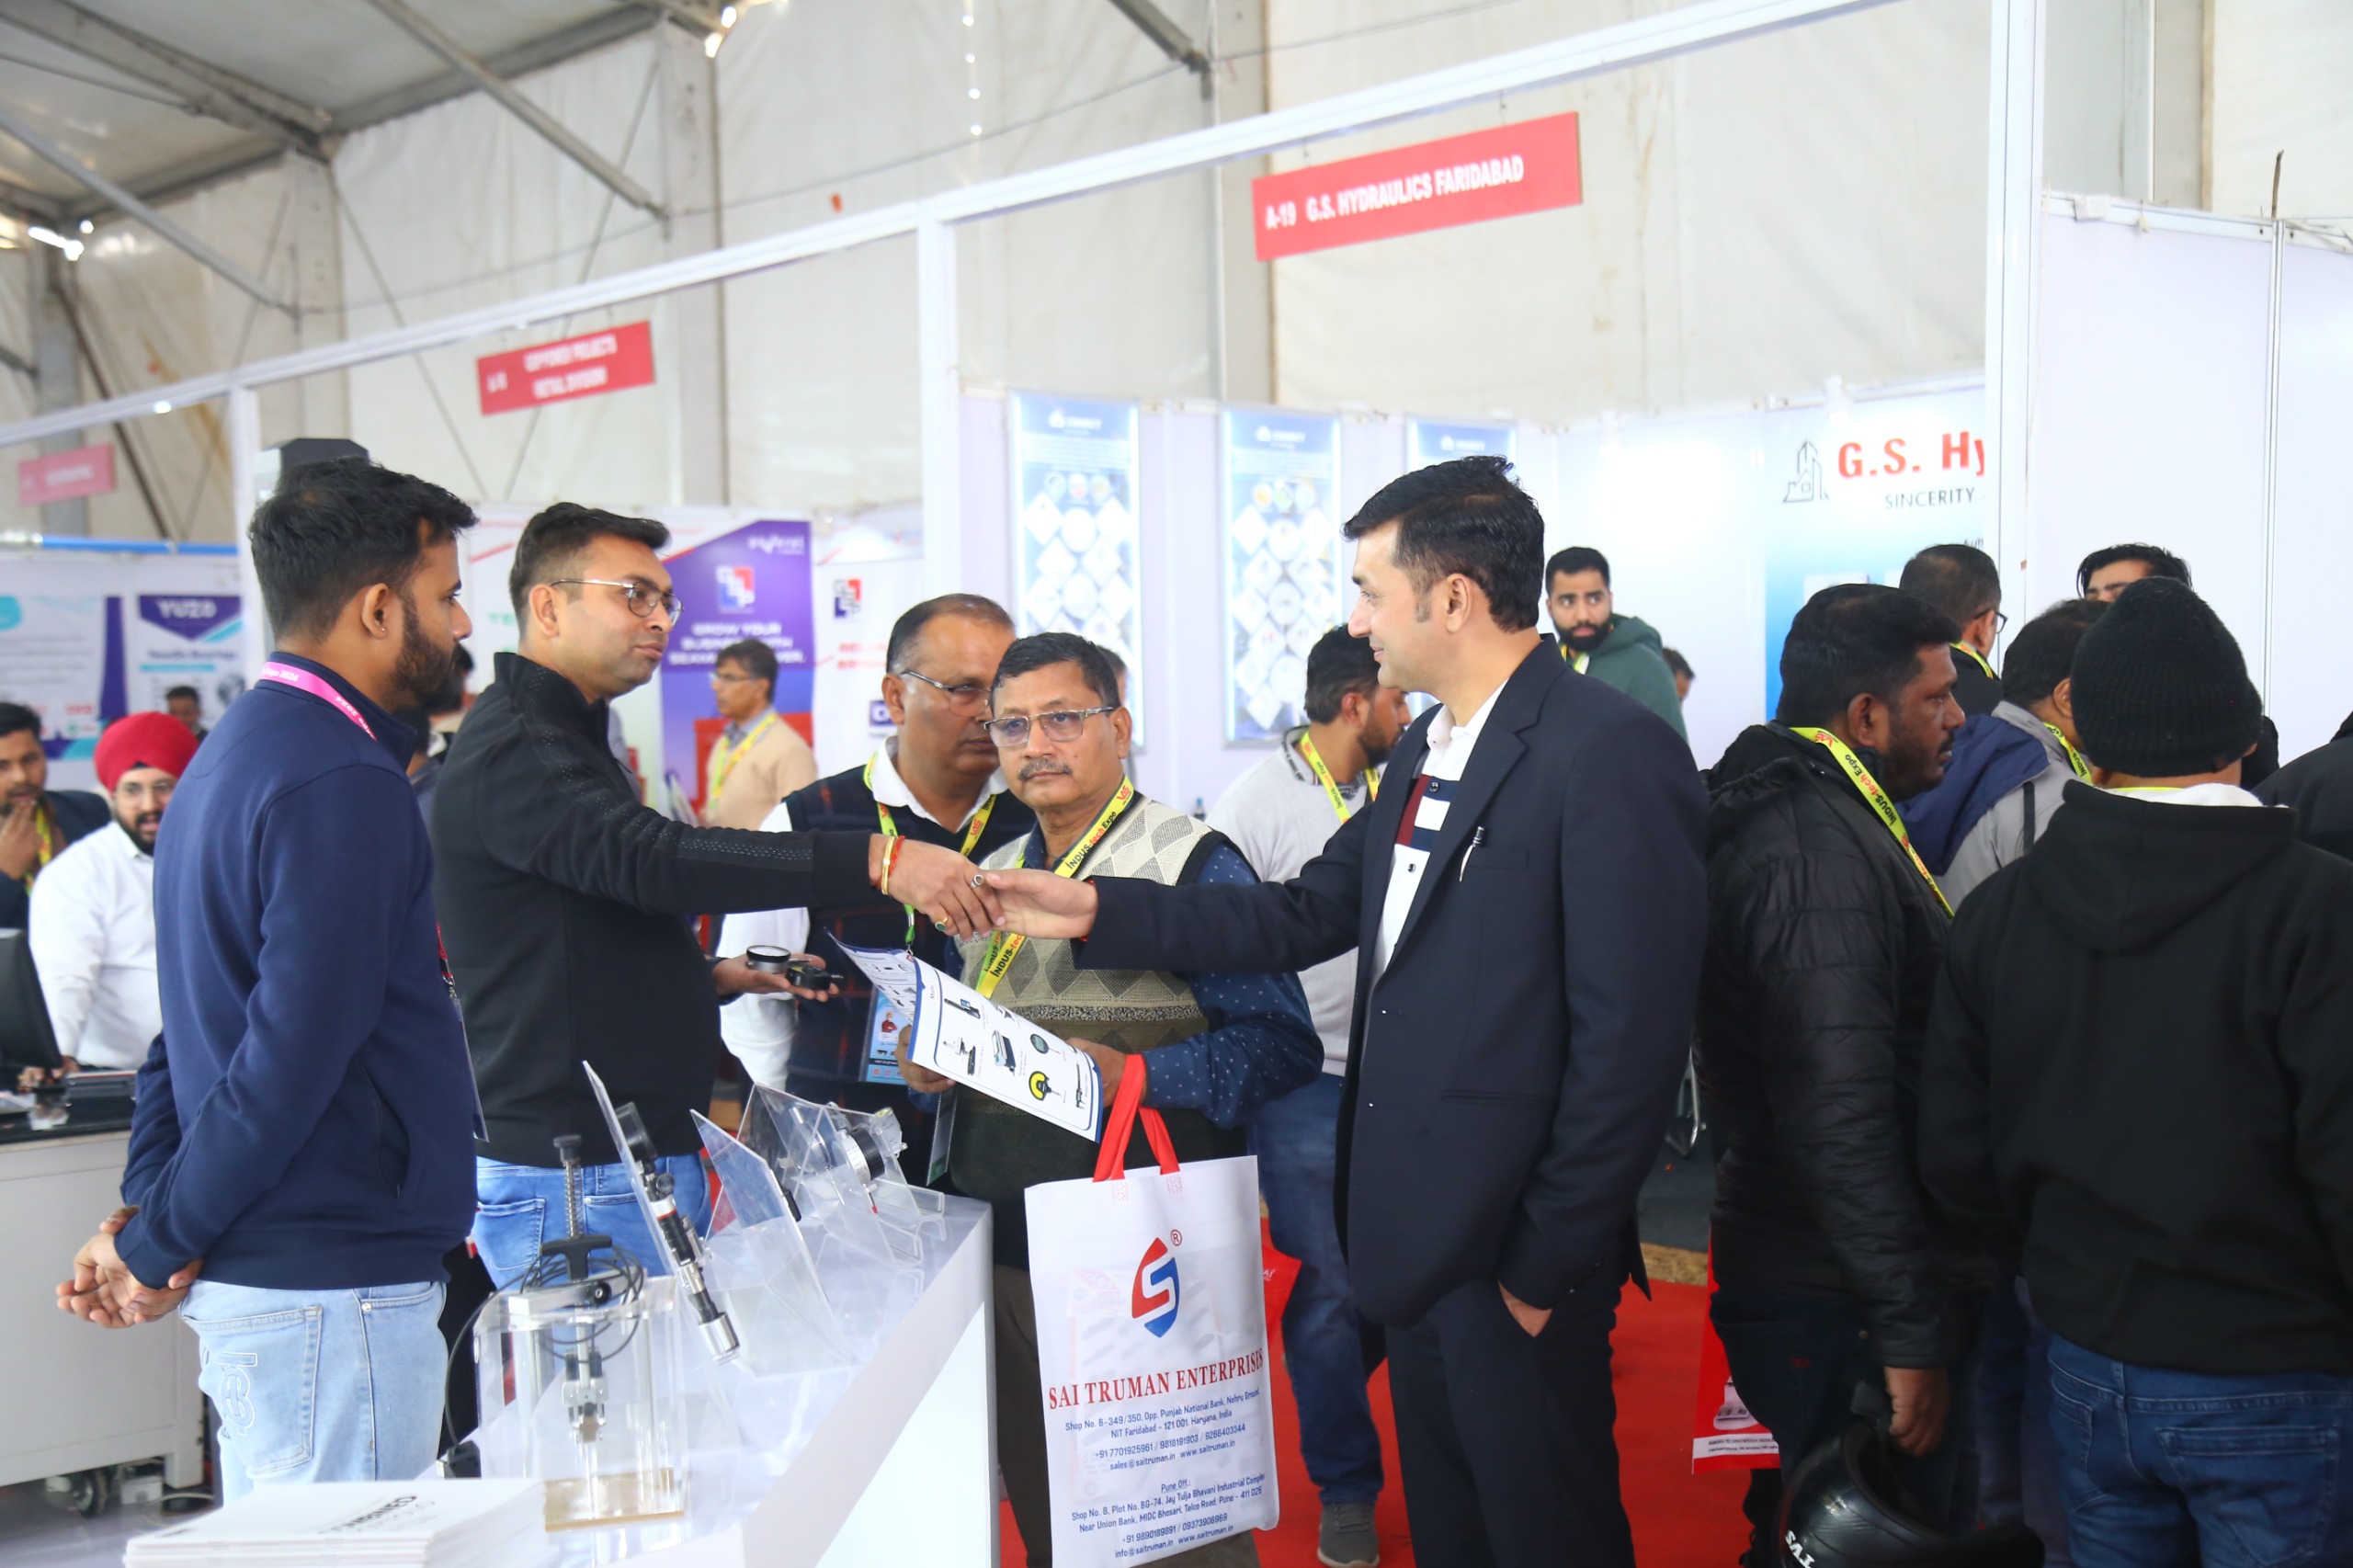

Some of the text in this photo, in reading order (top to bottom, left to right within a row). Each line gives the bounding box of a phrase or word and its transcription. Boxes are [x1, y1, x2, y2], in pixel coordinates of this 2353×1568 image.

[1266, 154, 1525, 229] A-19 G.S. HYDRAULICS FARIDABAD
[1837, 437, 1921, 479] G.S.
[1885, 487, 1975, 510] SINCERITY
[1845, 754, 1862, 777] Expo
[1116, 784, 1131, 801] VAS
[1101, 811, 1117, 829] Expo
[989, 934, 1023, 978] INDUS-tec
[1049, 1347, 1264, 1410] SAI TRUMAN ENTERPRISES
[1065, 1421, 1083, 1432] Shop
[1085, 1419, 1097, 1429] No.
[1144, 1411, 1159, 1422] Opp.
[1160, 1406, 1182, 1418] Punjab
[1184, 1401, 1210, 1414] National
[1226, 1393, 1244, 1404] Nehru
[1110, 1429, 1123, 1438] NIT
[1125, 1424, 1157, 1437] Faridabad
[1164, 1421, 1175, 1430] 121
[1219, 1409, 1233, 1419] India
[1095, 1449, 1108, 1459] +91
[1109, 1442, 1154, 1457] 7701925961
[1159, 1434, 1199, 1449] 9818191903
[1205, 1423, 1245, 1440] 9266403344
[1109, 1439, 1236, 1471] sales@saitruman.in www.saitruman.in
[1072, 1511, 1087, 1521] Shop
[1088, 1508, 1101, 1517] No.
[1111, 1505, 1125, 1514] Plot
[1127, 1503, 1139, 1512] No.
[1165, 1496, 1176, 1506] Jay
[1176, 1492, 1191, 1502] Tulja
[1192, 1487, 1216, 1498] Bhavani
[1217, 1478, 1245, 1492] Industrial
[1161, 1483, 1176, 1494] Pune
[1079, 1524, 1096, 1533] Near
[1097, 1519, 1117, 1529] Union
[1139, 1511, 1156, 1522] MIDC
[1185, 1503, 1200, 1513] Telco
[1219, 1495, 1233, 1505] Pune
[1240, 1490, 1250, 1499] 411
[1122, 1534, 1134, 1543] +91
[1136, 1525, 1176, 1541] 9890189891
[1182, 1513, 1228, 1531] 09373906969
[1115, 1525, 1233, 1558] info@saitruman.in www.saitruman.in
